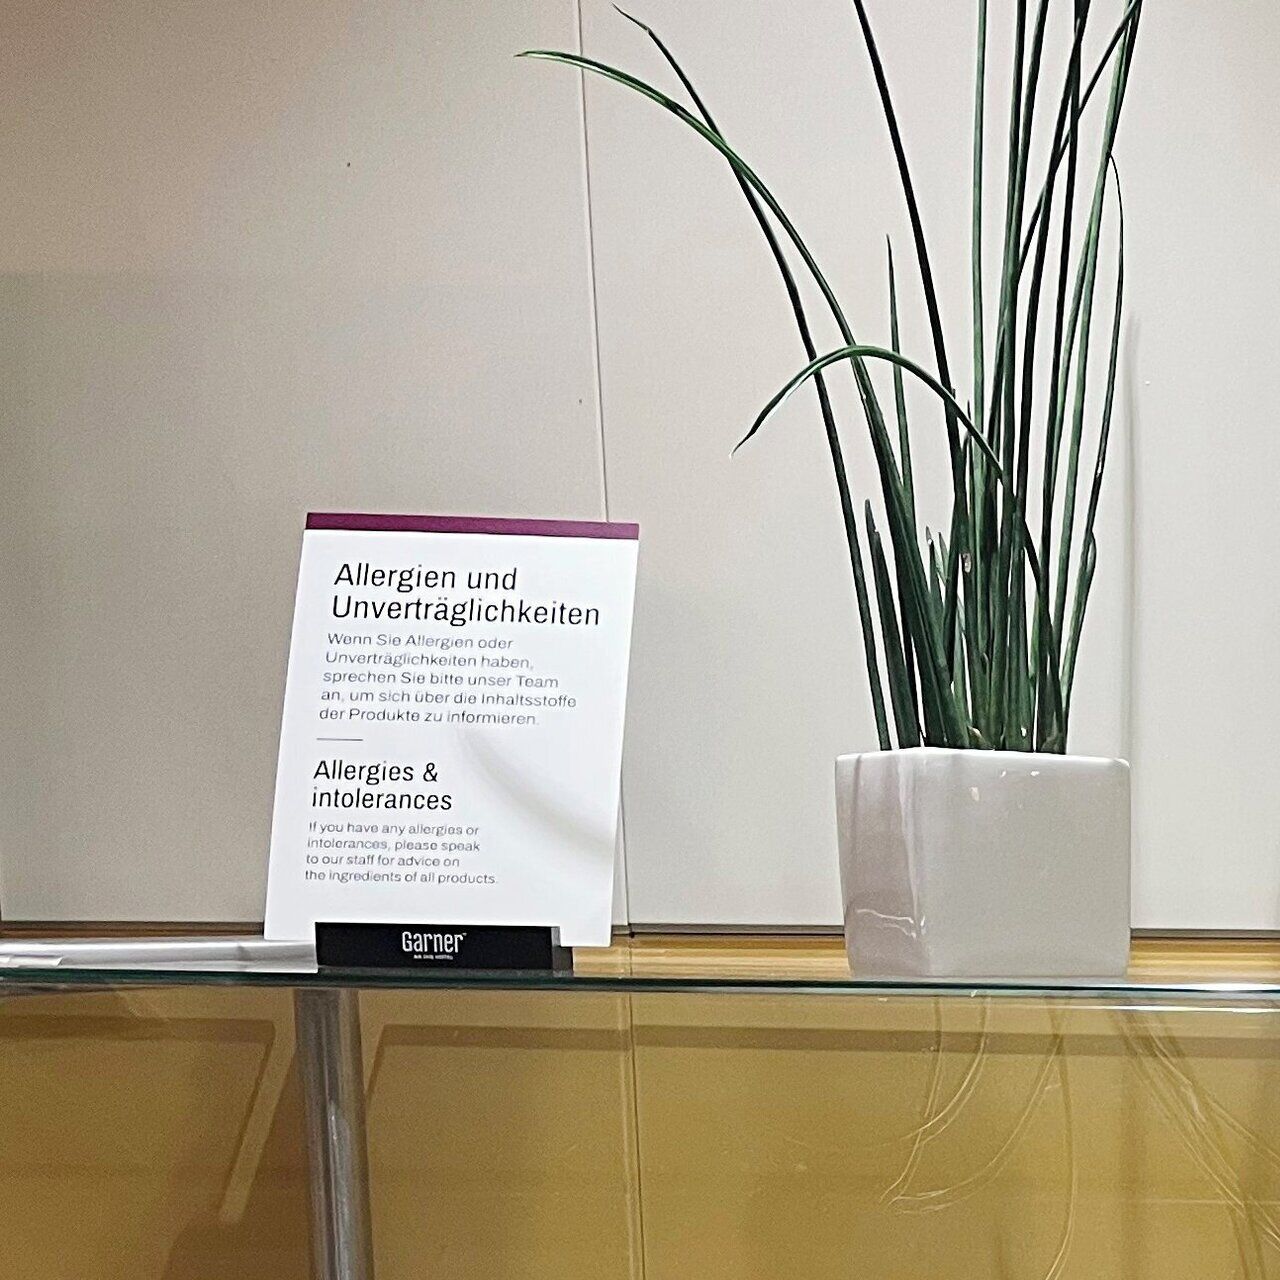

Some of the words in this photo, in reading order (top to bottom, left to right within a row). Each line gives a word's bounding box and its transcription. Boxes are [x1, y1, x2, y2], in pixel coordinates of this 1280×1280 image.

[333, 562, 456, 593] Allergien
[466, 567, 518, 591] und
[332, 595, 600, 627] Unverträglichkeiten
[327, 633, 372, 646] Wenn
[376, 634, 401, 647] Sie
[405, 634, 474, 650] Allergien
[477, 637, 514, 650] oder
[325, 651, 477, 668] Unverträglichkeiten
[481, 655, 534, 670] haben,
[323, 671, 396, 685] sprechen
[400, 672, 426, 685] Sie
[430, 672, 464, 686] bitte
[467, 675, 512, 687] unser
[515, 675, 559, 689] Team
[320, 690, 345, 703] an,
[349, 692, 374, 702] um
[378, 691, 410, 703] sich
[415, 690, 450, 704] über
[453, 692, 476, 705] die
[481, 693, 577, 708] Inhaltsstoffe
[319, 707, 345, 720] der
[349, 708, 420, 723] Produkte
[424, 711, 443, 722] zu
[447, 710, 540, 726] informieren.
[312, 759, 415, 785] Allergies
[422, 762, 439, 783] &
[311, 786, 453, 812] intolerances
[309, 821, 317, 832] If
[319, 824, 344, 835] you
[347, 822, 379, 834] have
[381, 825, 405, 837] any
[408, 824, 463, 837] allergies
[465, 827, 479, 836] or
[307, 838, 391, 852] intolerances,
[394, 840, 438, 853] please
[441, 840, 480, 853] speak
[306, 854, 319, 865] to
[322, 856, 344, 865] our
[346, 854, 375, 866] staff
[377, 854, 395, 866] for
[397, 855, 440, 867] advice
[443, 857, 460, 867] on
[305, 870, 325, 881] the
[328, 871, 401, 884] ingredients
[404, 872, 417, 883] of
[420, 872, 435, 883] all
[402, 931, 464, 953] Garner
